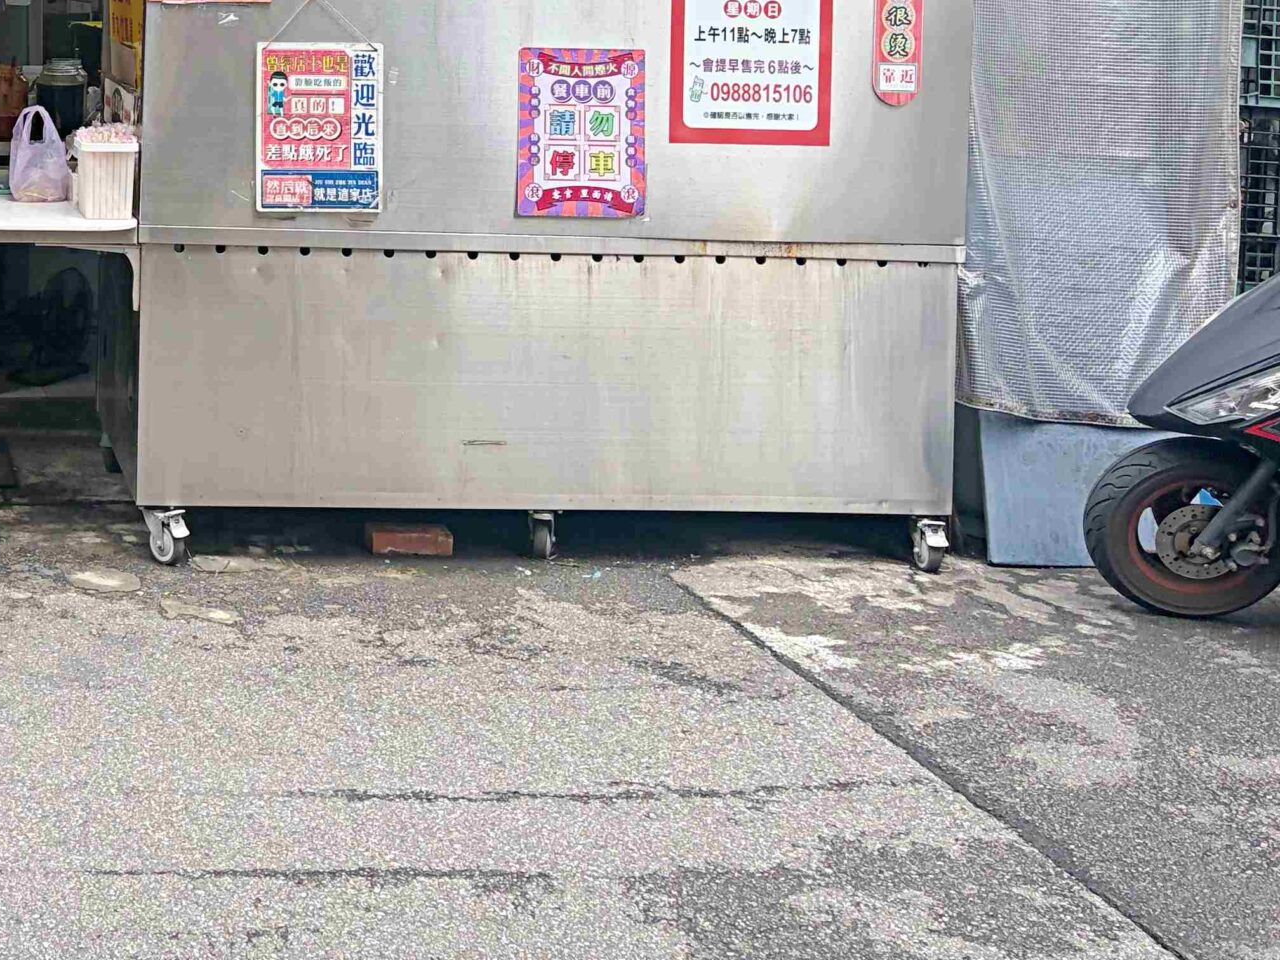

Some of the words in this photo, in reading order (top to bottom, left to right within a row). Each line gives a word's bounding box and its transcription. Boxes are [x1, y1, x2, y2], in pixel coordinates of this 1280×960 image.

[726, 0, 780, 18] 星期日
[553, 83, 612, 100] 餐車前
[710, 81, 813, 104] 0988815106
[353, 53, 376, 167] 歡迎光臨
[549, 109, 615, 137] 請勿
[266, 144, 349, 162] 差點餓死了
[549, 150, 615, 177] 停車
